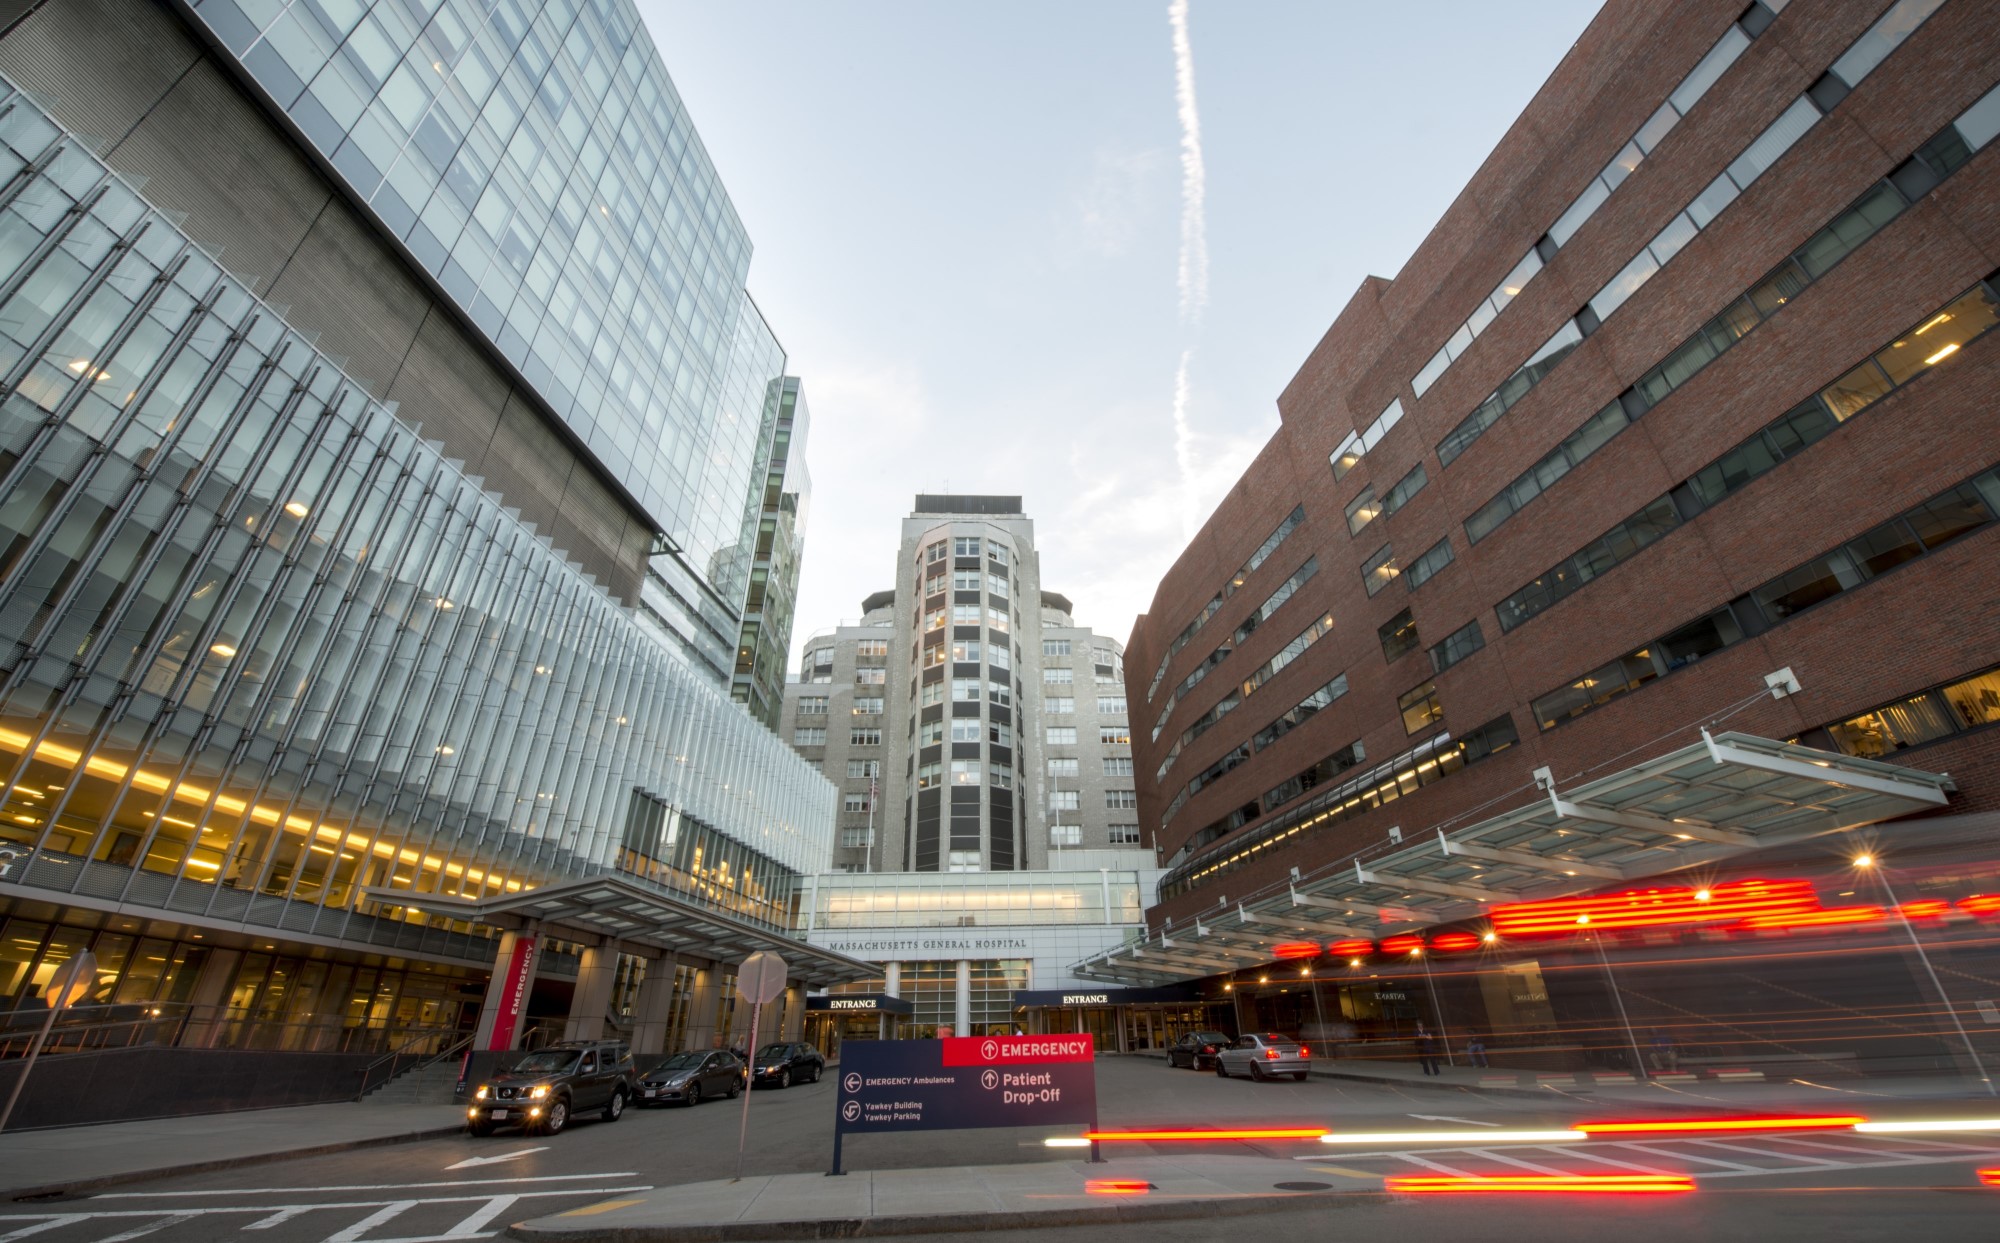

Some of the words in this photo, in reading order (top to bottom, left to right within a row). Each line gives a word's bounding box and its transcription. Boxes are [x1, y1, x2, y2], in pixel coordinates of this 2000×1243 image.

[829, 940, 919, 950] MASSACHUSETTS
[923, 940, 970, 949] GENERAL
[975, 939, 1026, 948] HOSPITAL
[511, 944, 533, 1015] EMERGENCY
[1063, 994, 1108, 1004] ENTRANCE
[830, 1000, 877, 1009] ENTRANCE
[1001, 1041, 1087, 1057] EMERGENCY
[865, 1077, 912, 1086] EMERGENCY
[913, 1076, 955, 1085] Ambulances
[1003, 1072, 1051, 1086] Patient
[1003, 1088, 1061, 1105] Drop-Off
[865, 1102, 893, 1111] Yawkey
[894, 1101, 923, 1110] Building
[864, 1113, 892, 1122] Yawkey
[894, 1112, 921, 1121] Parking
